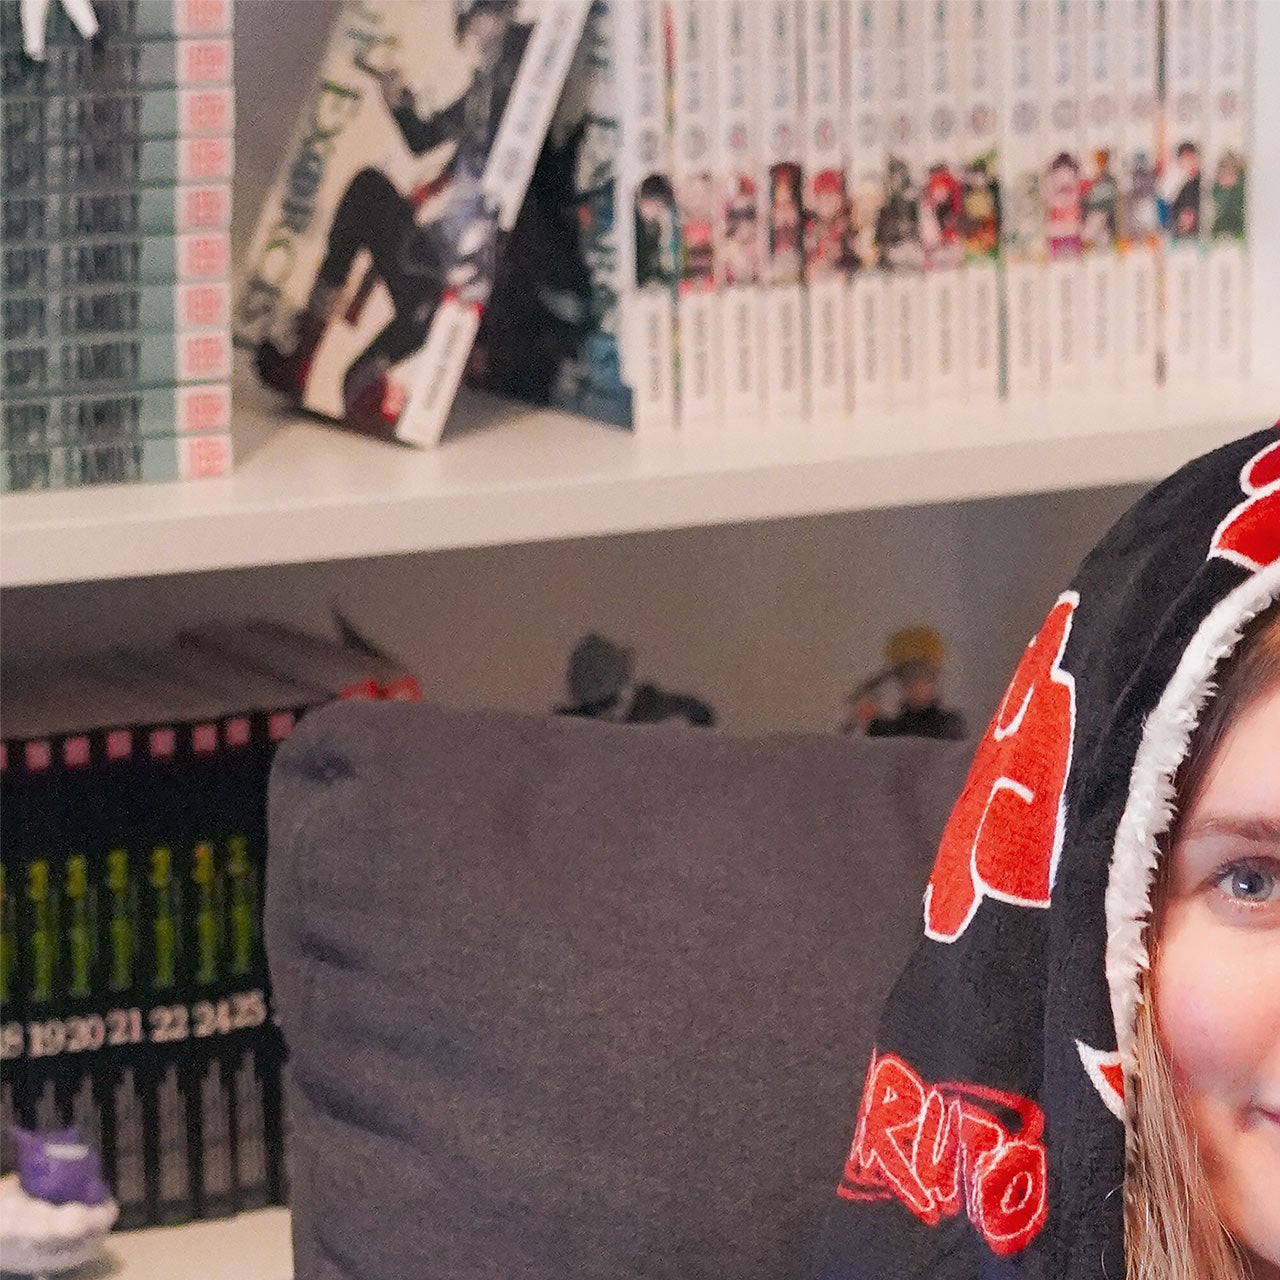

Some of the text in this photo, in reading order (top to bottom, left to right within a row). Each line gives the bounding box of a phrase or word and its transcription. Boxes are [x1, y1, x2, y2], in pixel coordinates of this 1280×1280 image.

[65, 1014, 105, 1052] 20
[106, 1007, 143, 1045] 21
[150, 1004, 190, 1042] 22
[192, 1001, 230, 1037] 24
